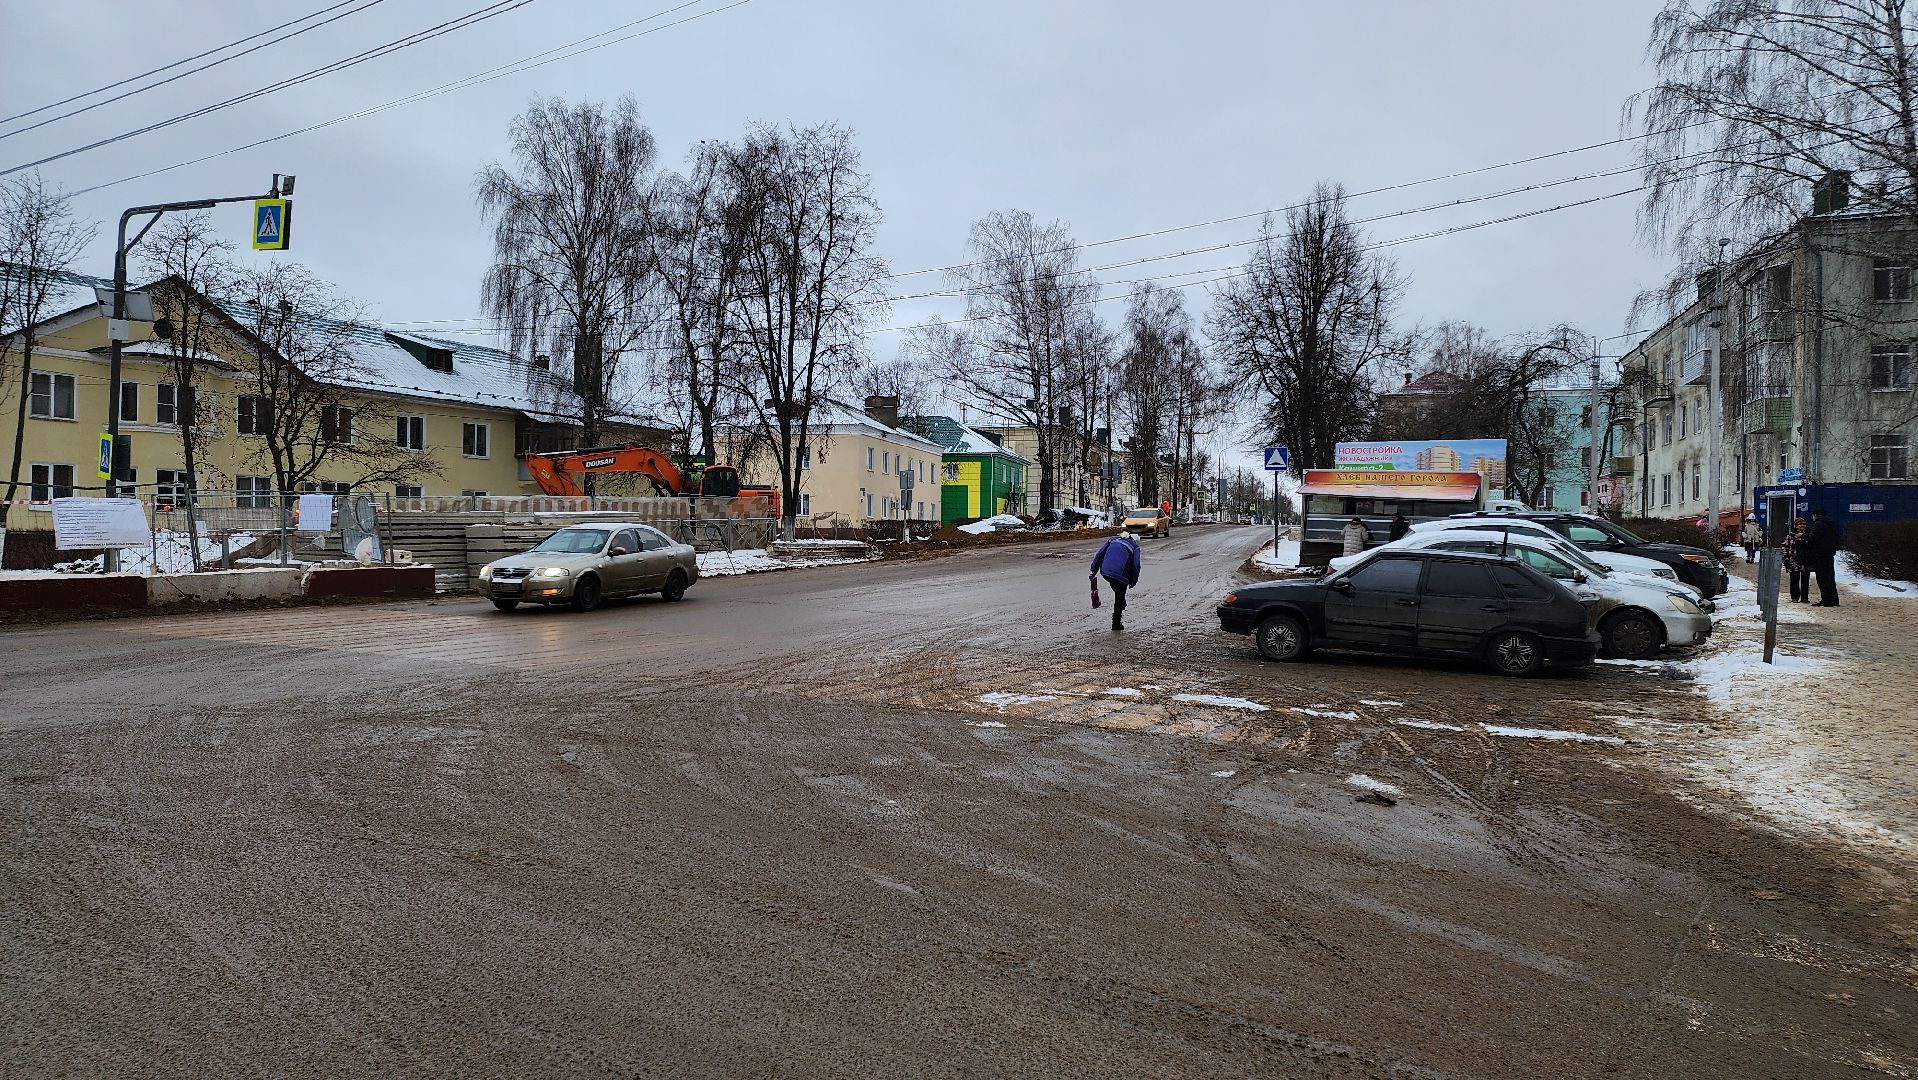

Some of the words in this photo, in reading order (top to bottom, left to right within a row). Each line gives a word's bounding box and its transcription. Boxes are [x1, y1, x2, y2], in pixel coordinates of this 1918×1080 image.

[1338, 446, 1403, 455] НОВОСТРОЙКА
[585, 457, 615, 468] DOOSAN
[1336, 473, 1361, 481] ХЛЕБ
[1365, 474, 1406, 482] НАШЕГО
[1410, 474, 1447, 482] ГОРОДА
